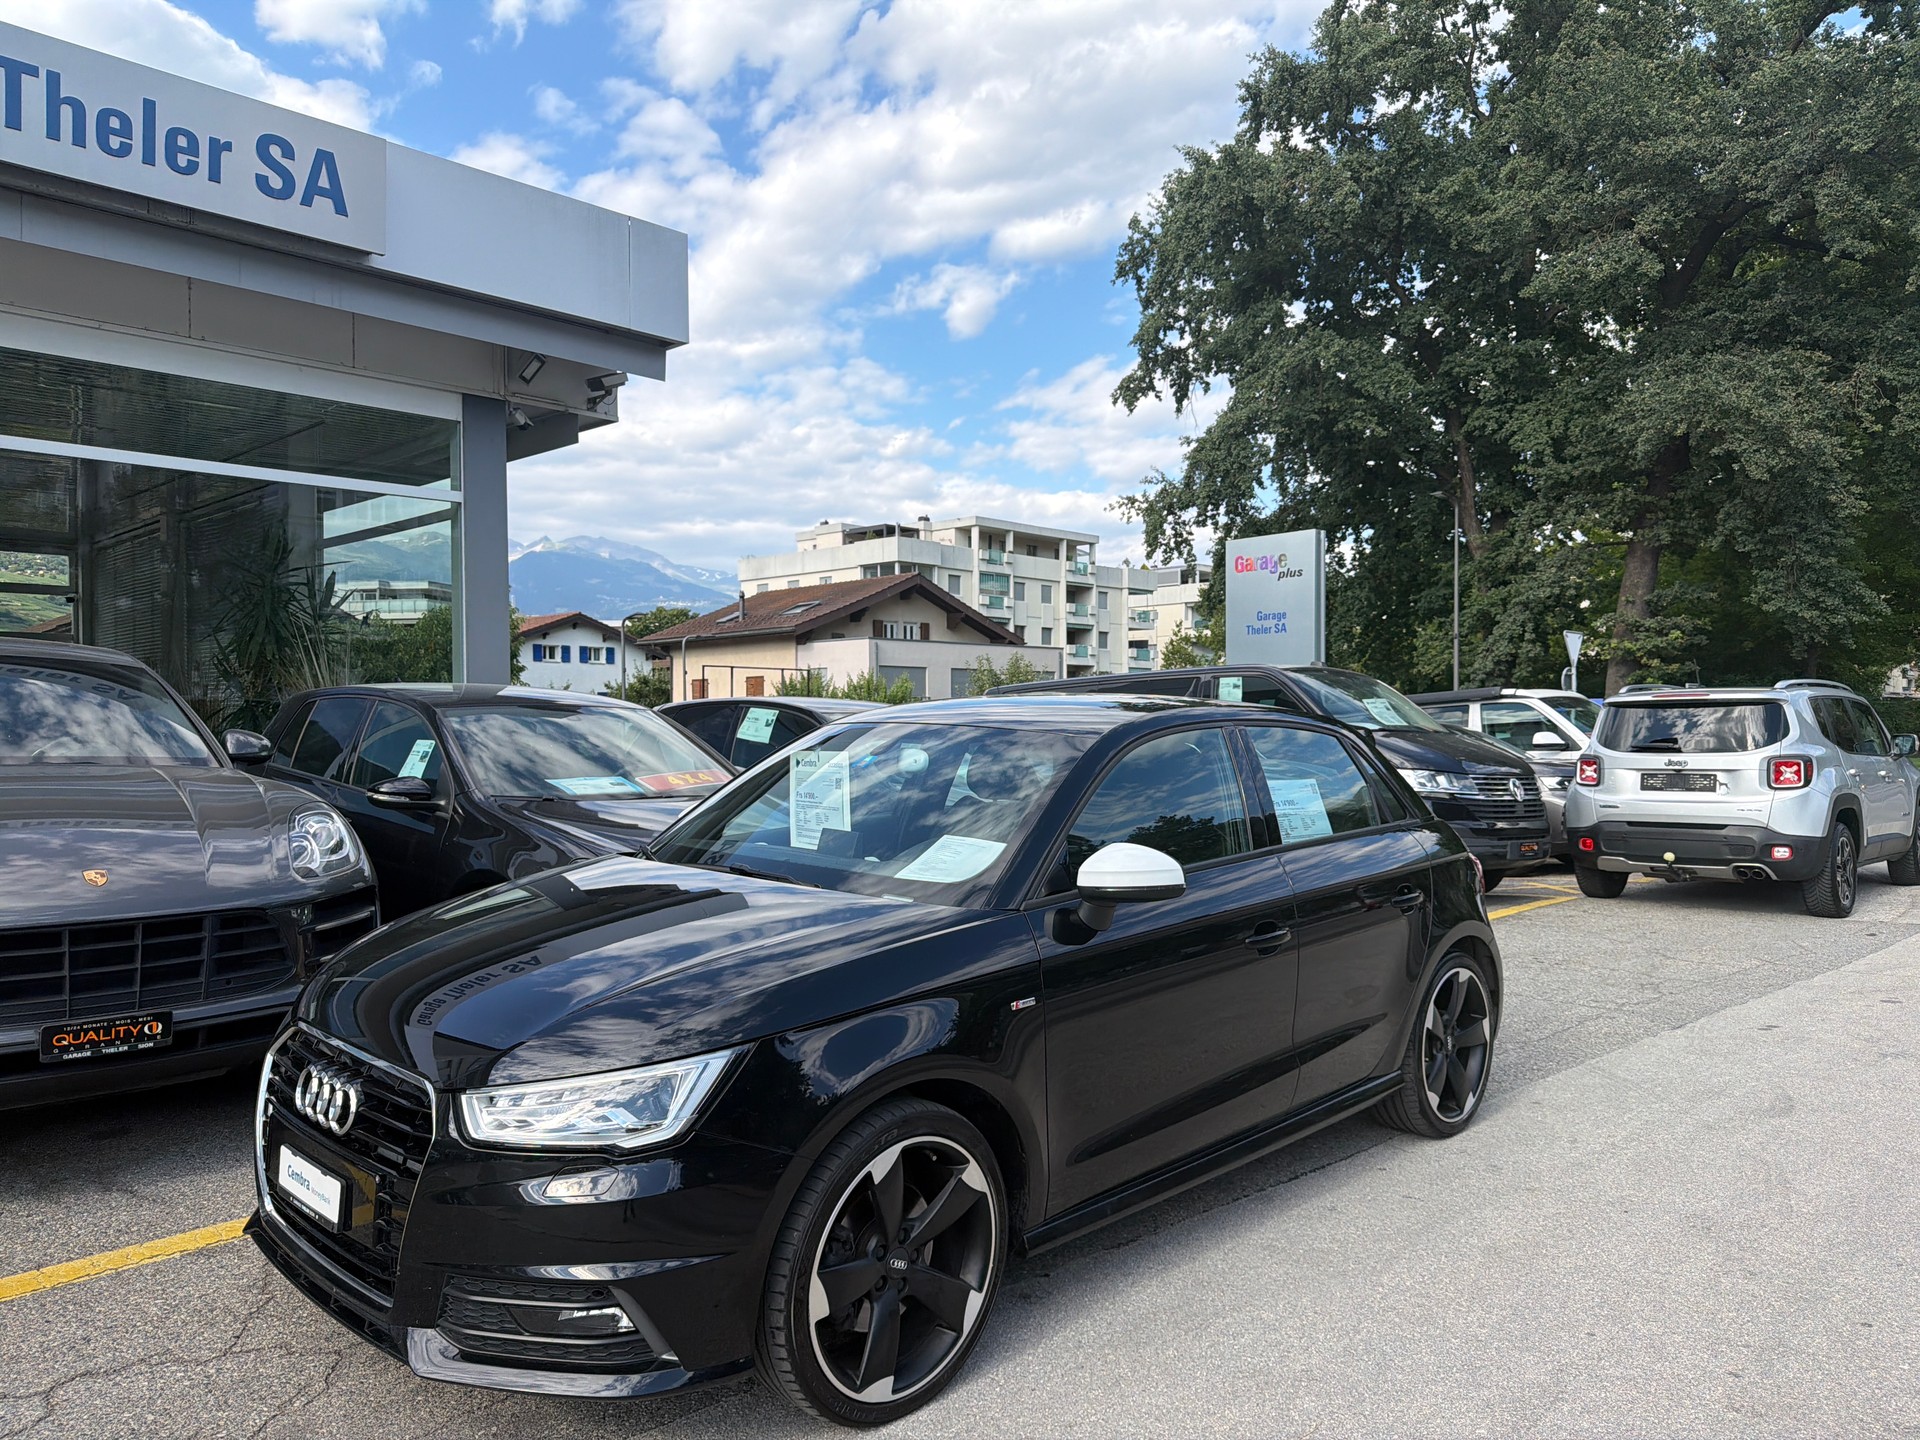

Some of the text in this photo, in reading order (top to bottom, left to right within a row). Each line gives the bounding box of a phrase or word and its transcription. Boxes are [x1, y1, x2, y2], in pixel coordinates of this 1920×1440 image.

[0, 55, 349, 218] Theler SA
[1234, 553, 1288, 575] Garage
[1277, 567, 1304, 581] plus
[1256, 610, 1287, 622] Garage
[1246, 622, 1287, 635] Theler SA
[1664, 759, 1689, 768] Jeep
[52, 1024, 142, 1047] QUALITY
[62, 1041, 154, 1060] GARAGE THELER SION
[287, 1164, 311, 1192] Cembra
